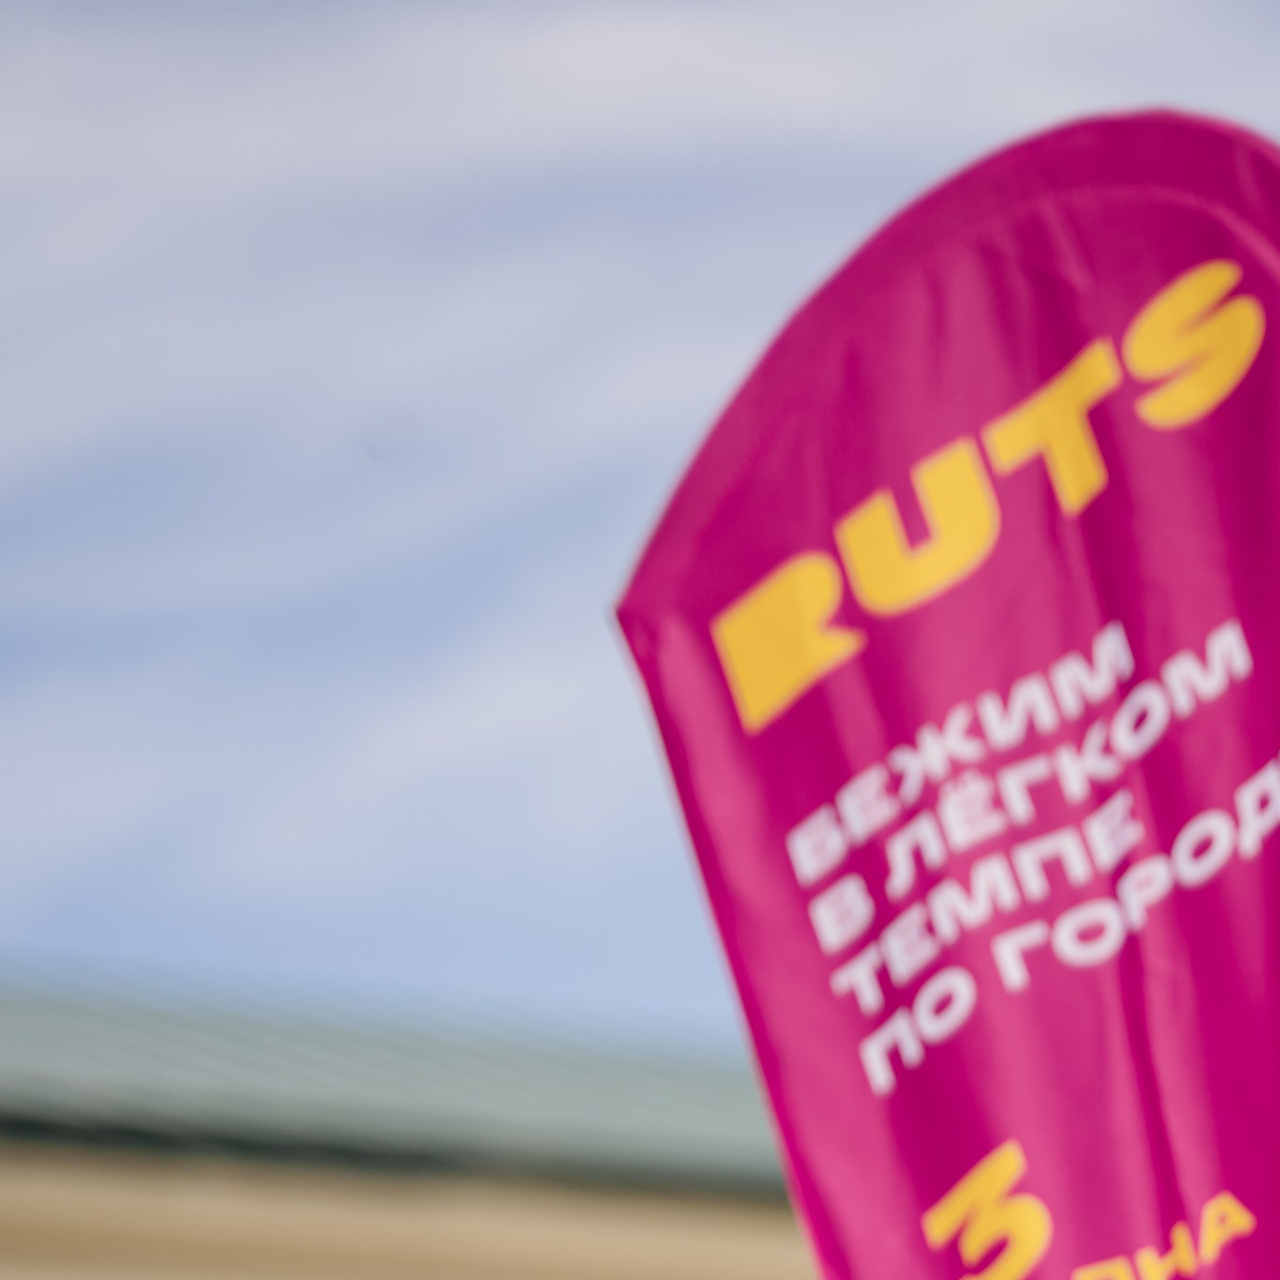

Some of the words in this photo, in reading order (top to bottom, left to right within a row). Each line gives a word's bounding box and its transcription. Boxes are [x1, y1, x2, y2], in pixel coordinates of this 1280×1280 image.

[710, 257, 1267, 738] RUTS
[784, 618, 1136, 887] БЕЖИМ
[807, 872, 876, 956] В
[884, 618, 1254, 899] ЛЁГКОМ
[829, 787, 1146, 1017] ТЕМПЕ
[858, 965, 978, 1097] ПО
